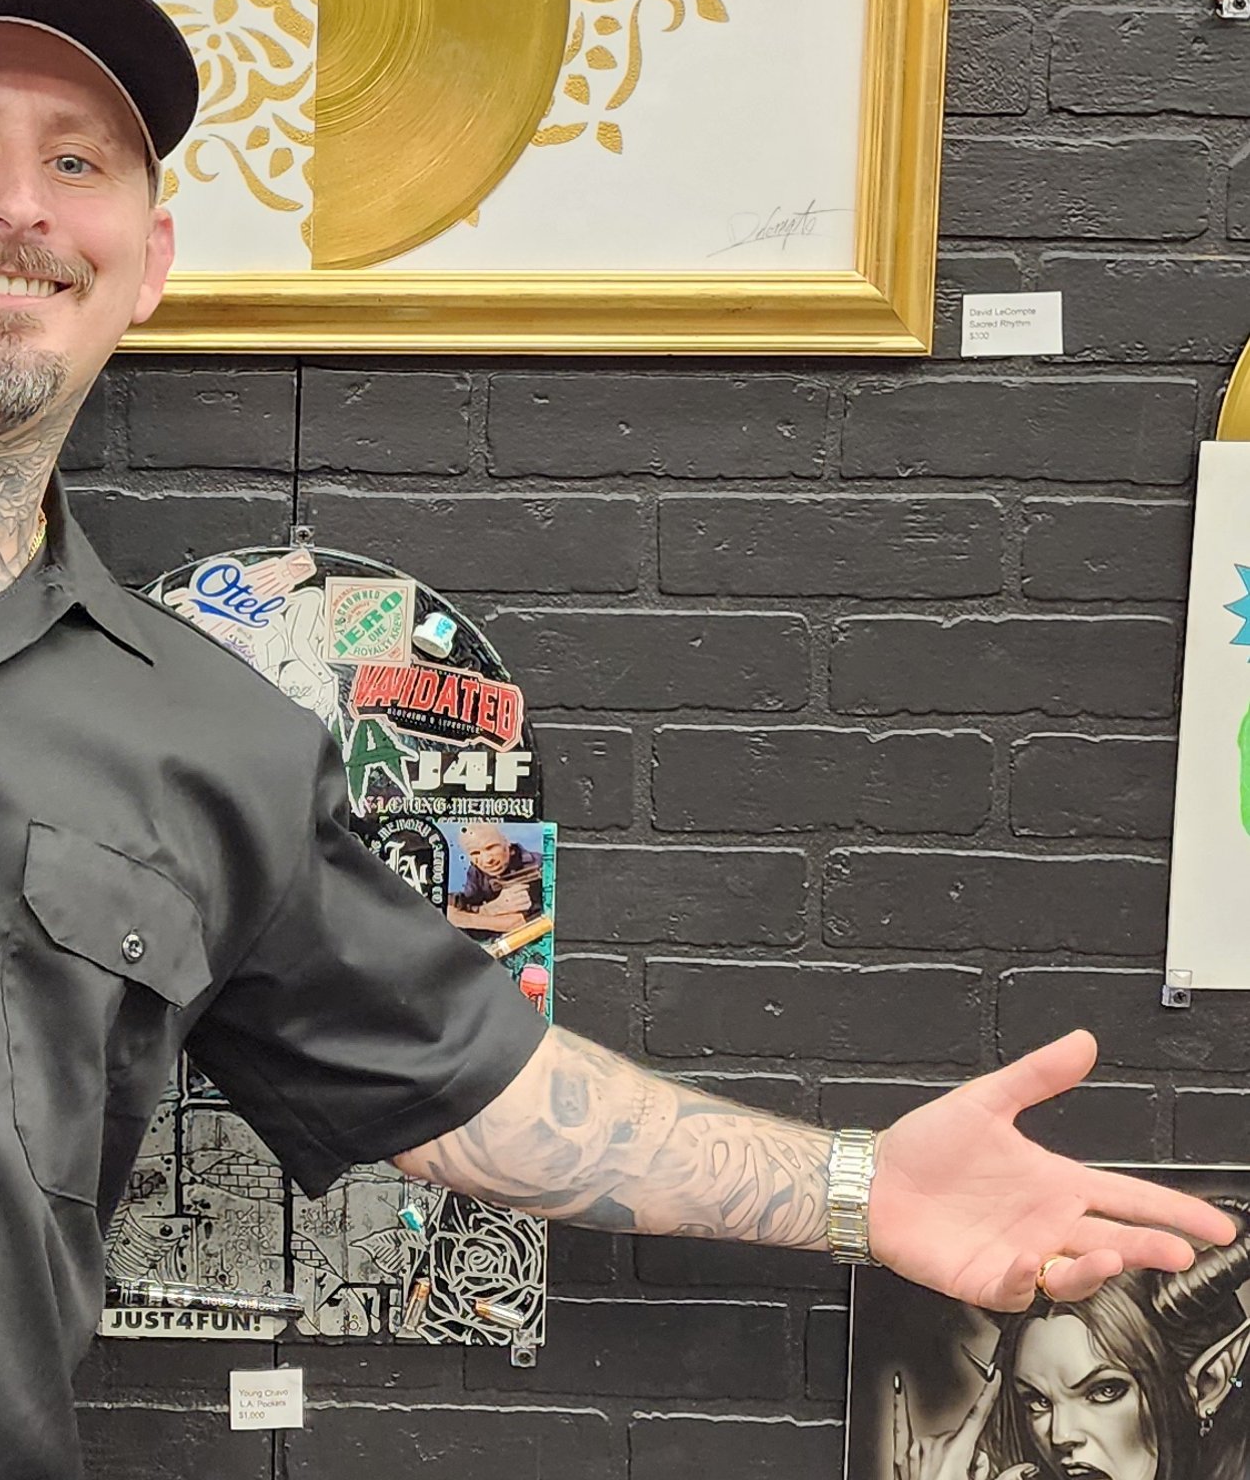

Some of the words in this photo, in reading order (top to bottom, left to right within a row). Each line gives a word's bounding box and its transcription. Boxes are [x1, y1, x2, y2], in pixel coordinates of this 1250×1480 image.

[969, 308, 993, 317] David
[969, 320, 998, 329] Sacred
[1000, 320, 1031, 329] Rhythm
[410, 750, 533, 792] J4F
[111, 1310, 262, 1332] JUST4FUN!
[238, 1389, 263, 1398] Young
